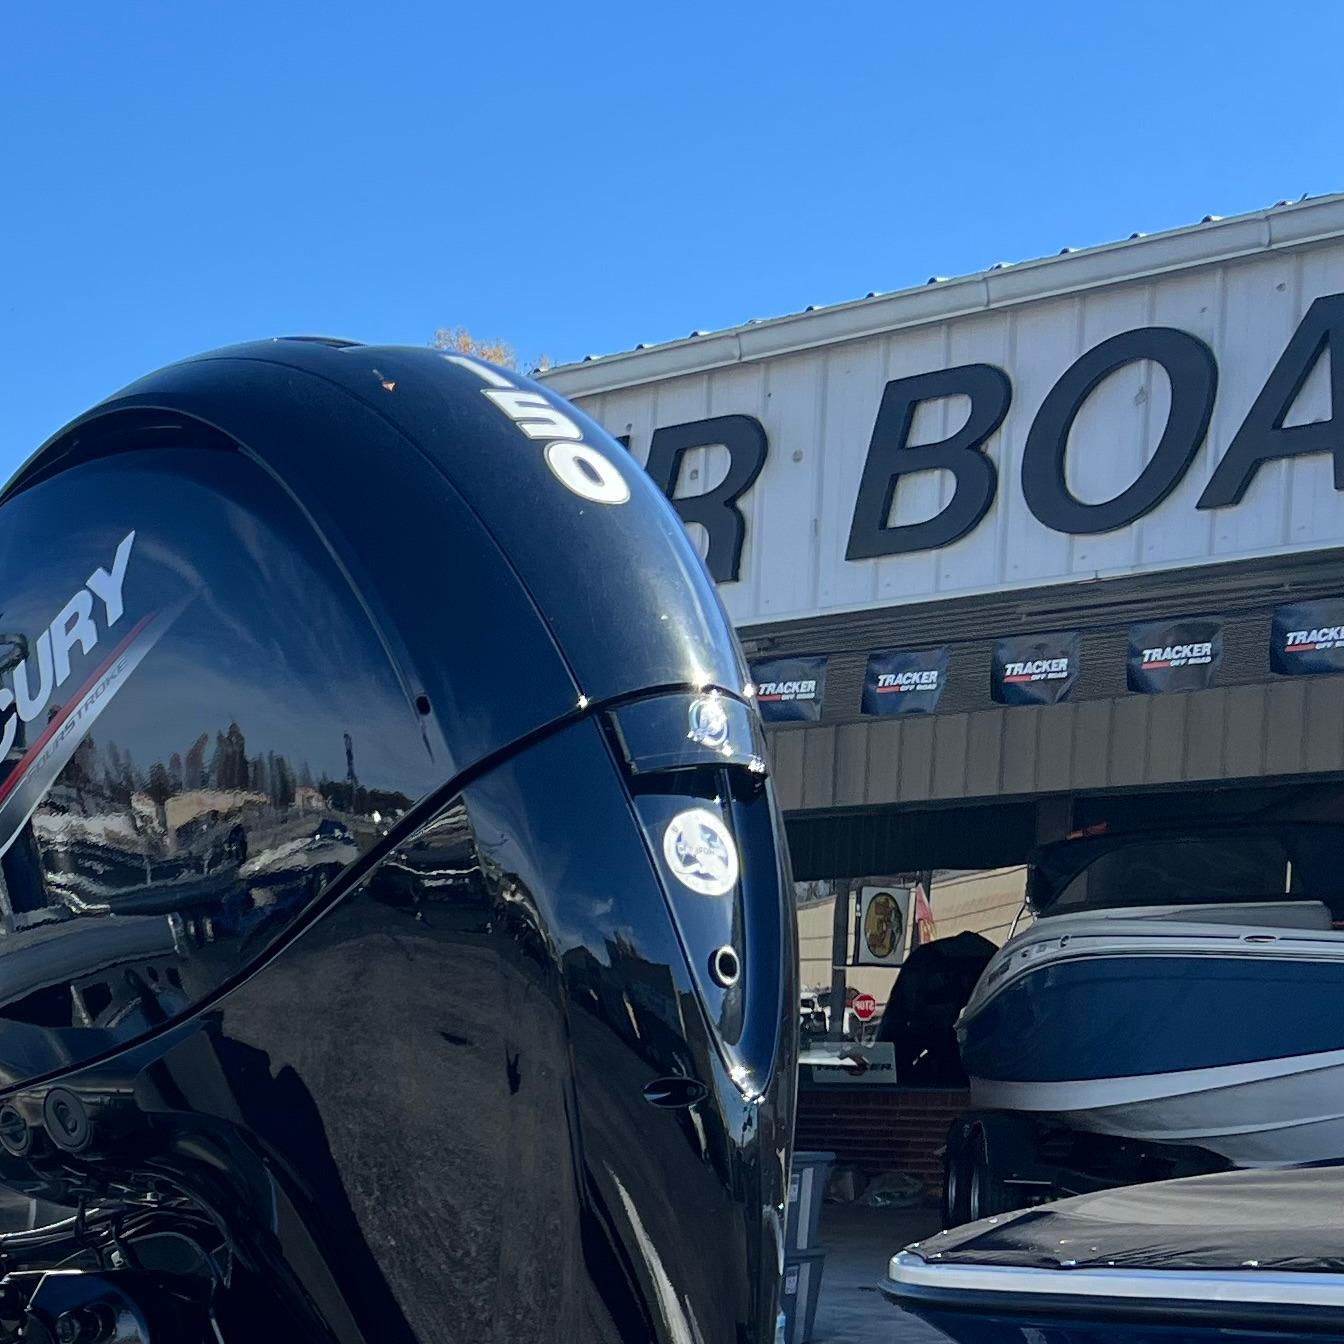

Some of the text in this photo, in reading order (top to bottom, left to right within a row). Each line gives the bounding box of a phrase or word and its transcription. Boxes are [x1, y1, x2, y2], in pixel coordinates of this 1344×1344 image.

[440, 354, 630, 504] 150
[617, 414, 768, 583] R
[1142, 642, 1212, 662] TRACKER
[1170, 656, 1212, 667] OFF ROAD
[1004, 658, 1069, 676] TRACKER
[758, 680, 817, 696] TRACKER
[877, 671, 939, 687] TRACKER
[26, 655, 129, 782] FOURSTROKE
